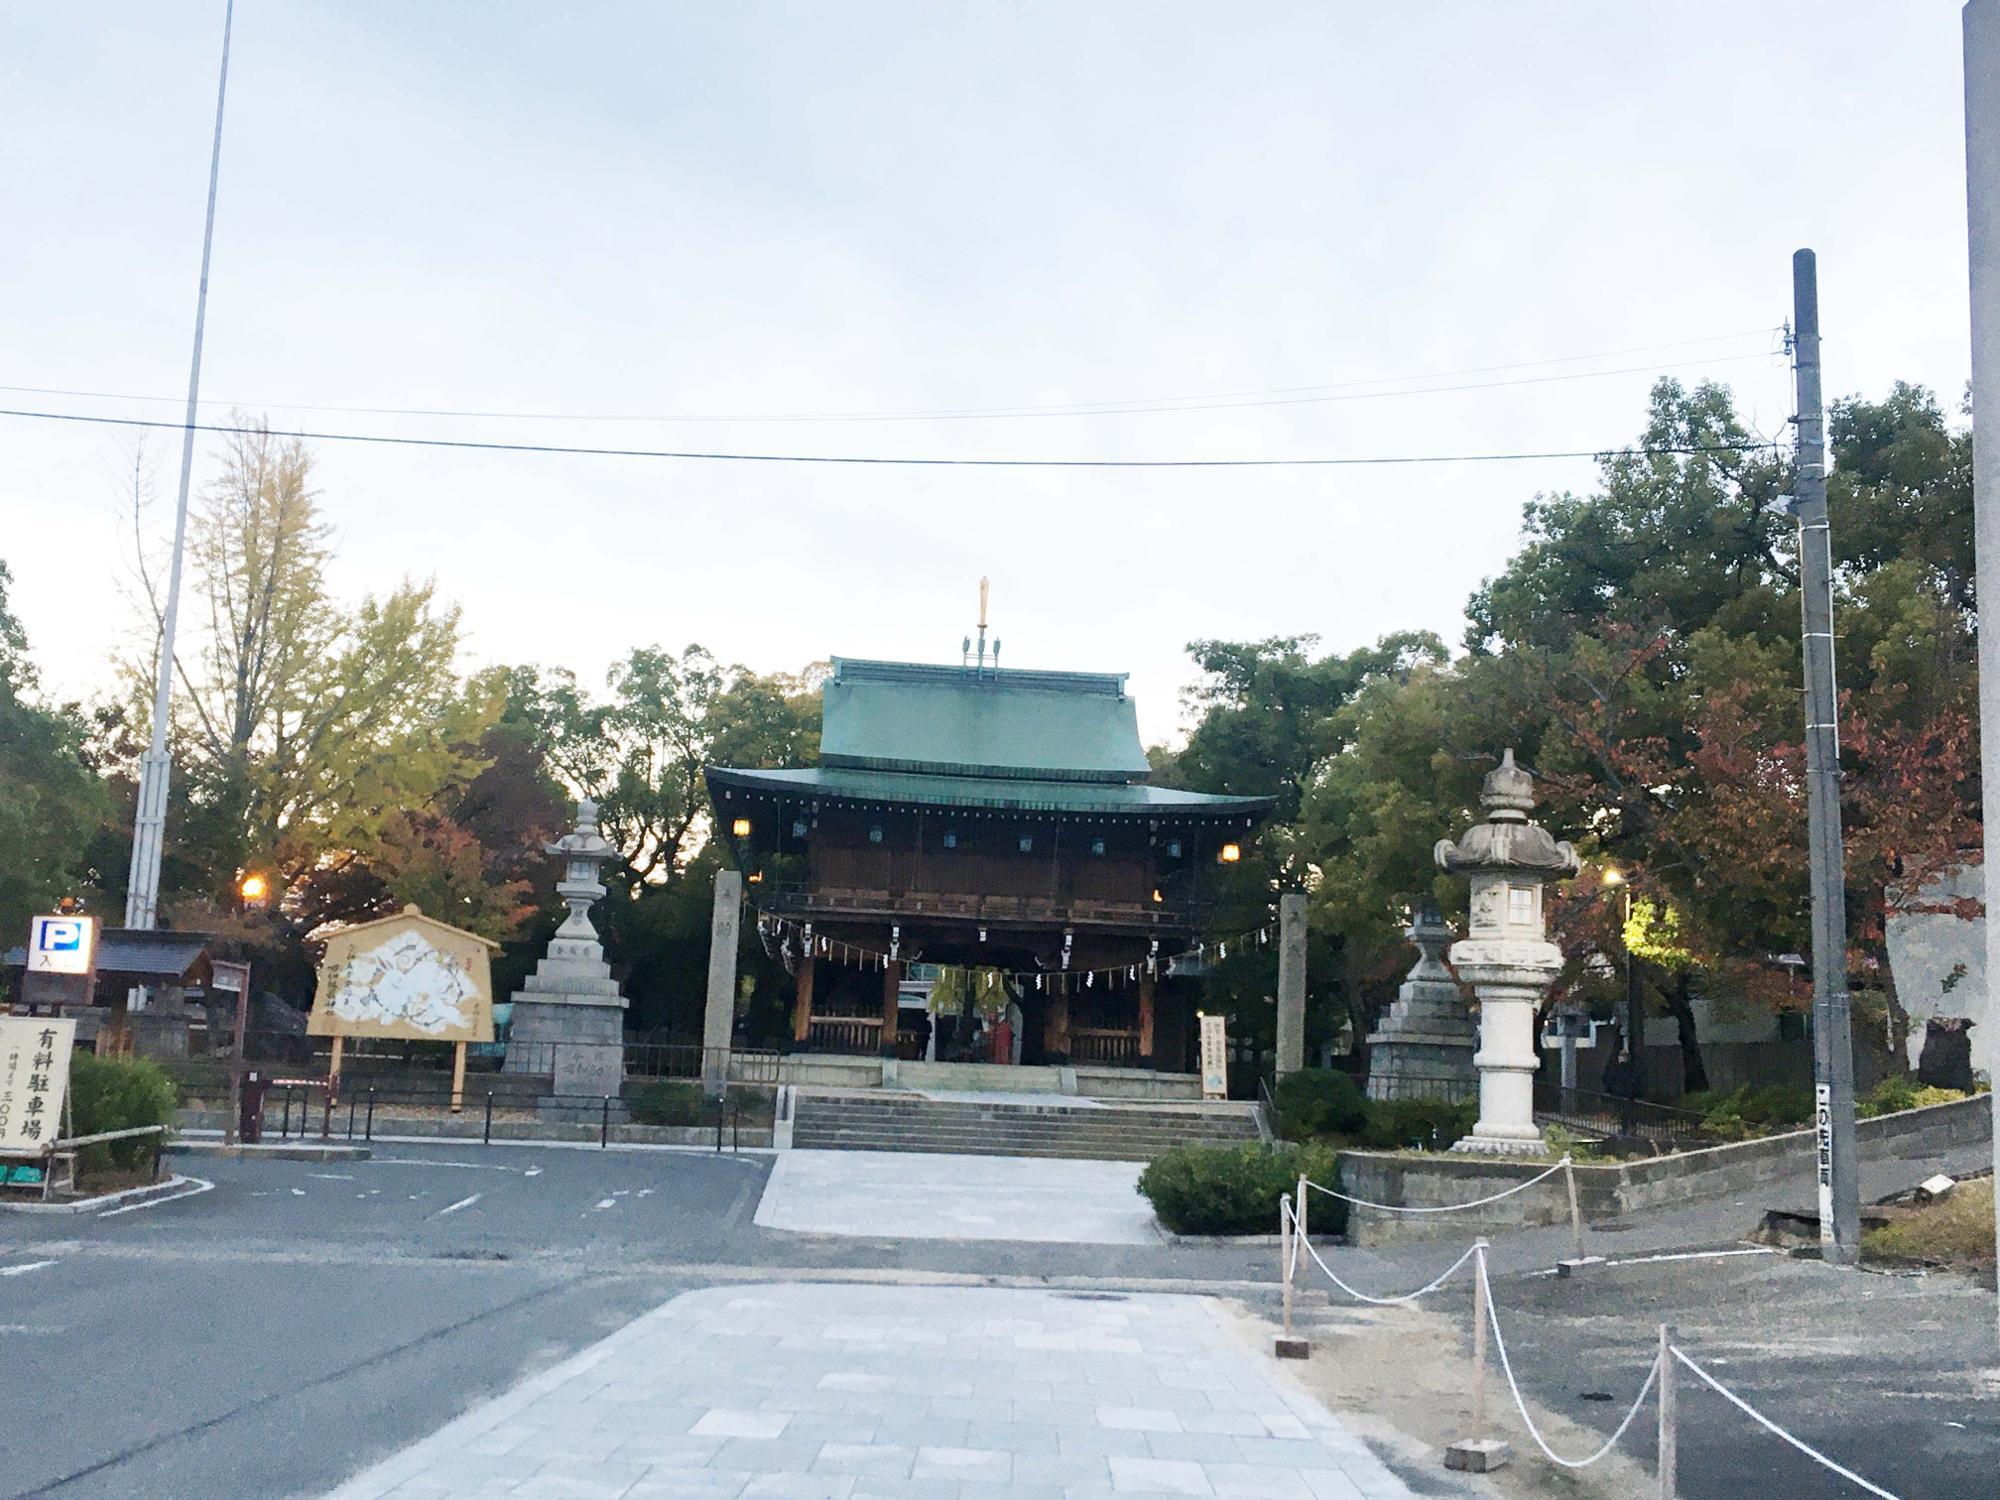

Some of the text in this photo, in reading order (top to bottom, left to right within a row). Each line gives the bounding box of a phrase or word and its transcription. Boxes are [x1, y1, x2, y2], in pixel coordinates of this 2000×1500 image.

[44, 922, 80, 950] P
[20, 1028, 58, 1140] 有料駐車場
